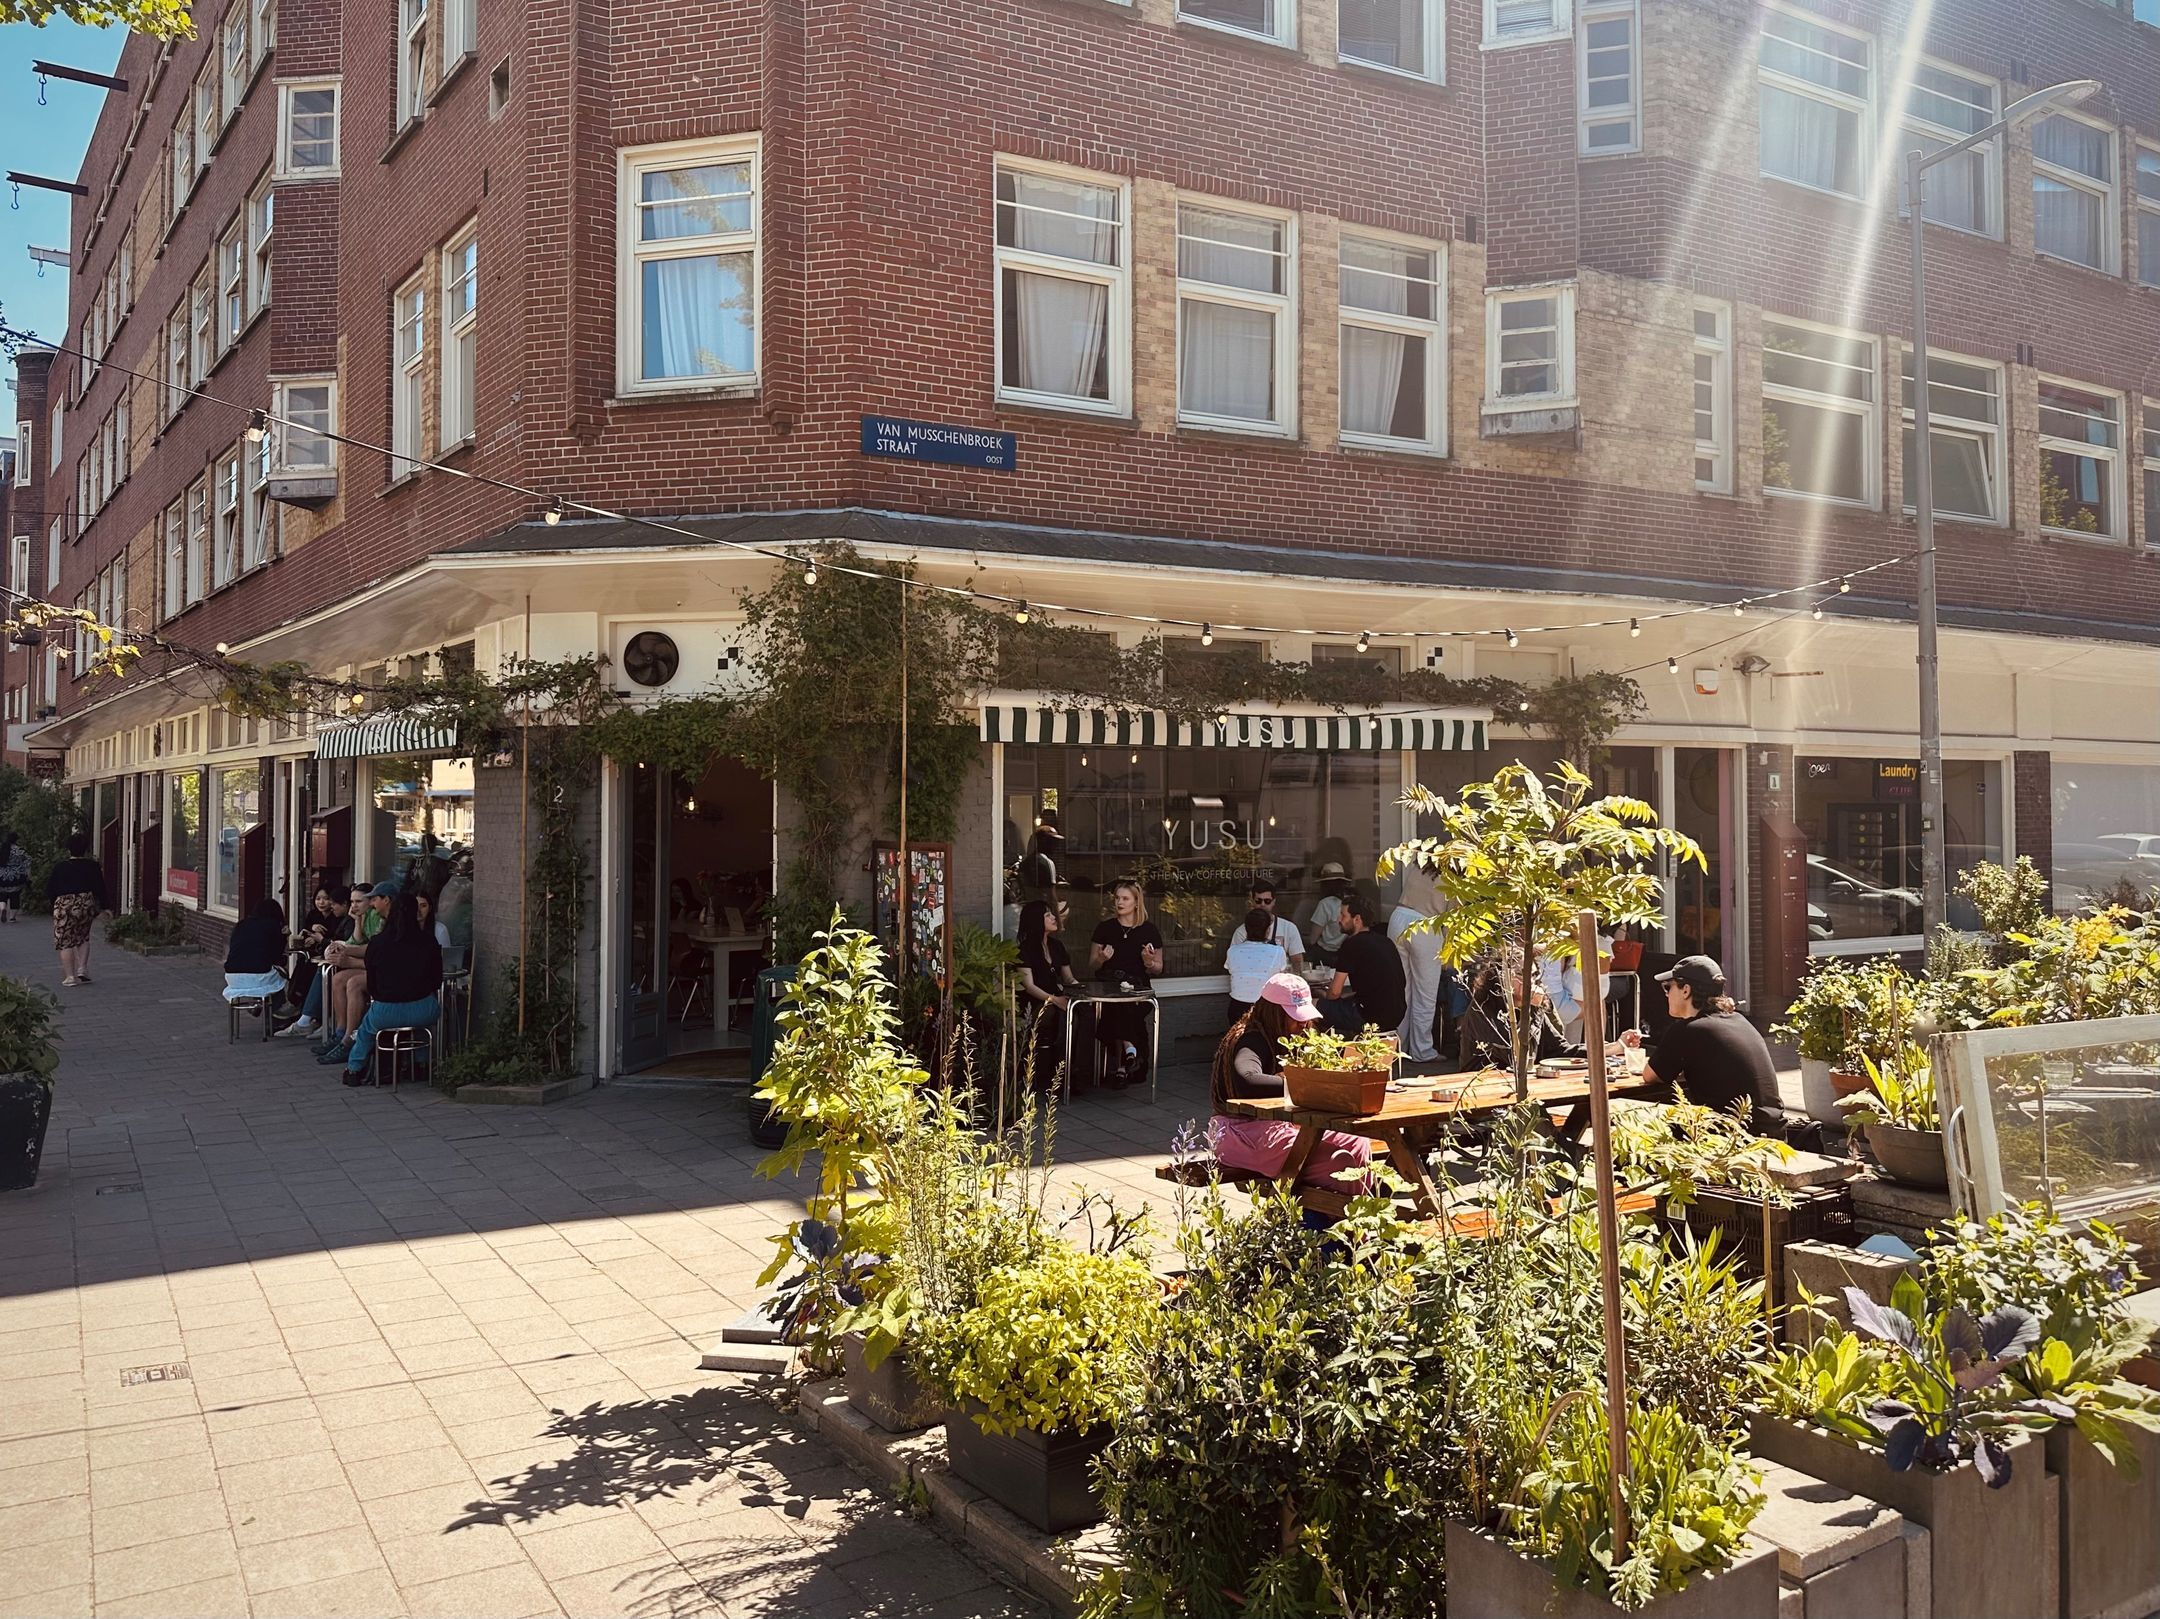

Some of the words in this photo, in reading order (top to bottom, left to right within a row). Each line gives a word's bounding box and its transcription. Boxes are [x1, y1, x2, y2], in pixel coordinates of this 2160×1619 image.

[876, 422, 901, 437] VAN
[907, 426, 1003, 450] MUSSCHENBROEK
[876, 438, 918, 455] STRAAT
[985, 455, 1003, 465] OOST
[1214, 718, 1295, 744] YUSU
[1879, 763, 1918, 781] Laundry
[553, 785, 564, 803] 2
[1162, 820, 1264, 850] YUSU
[1152, 870, 1170, 881] THE
[1172, 870, 1194, 881] NEW
[1196, 869, 1232, 880] COFFEE
[1233, 868, 1273, 879] CULTURE
